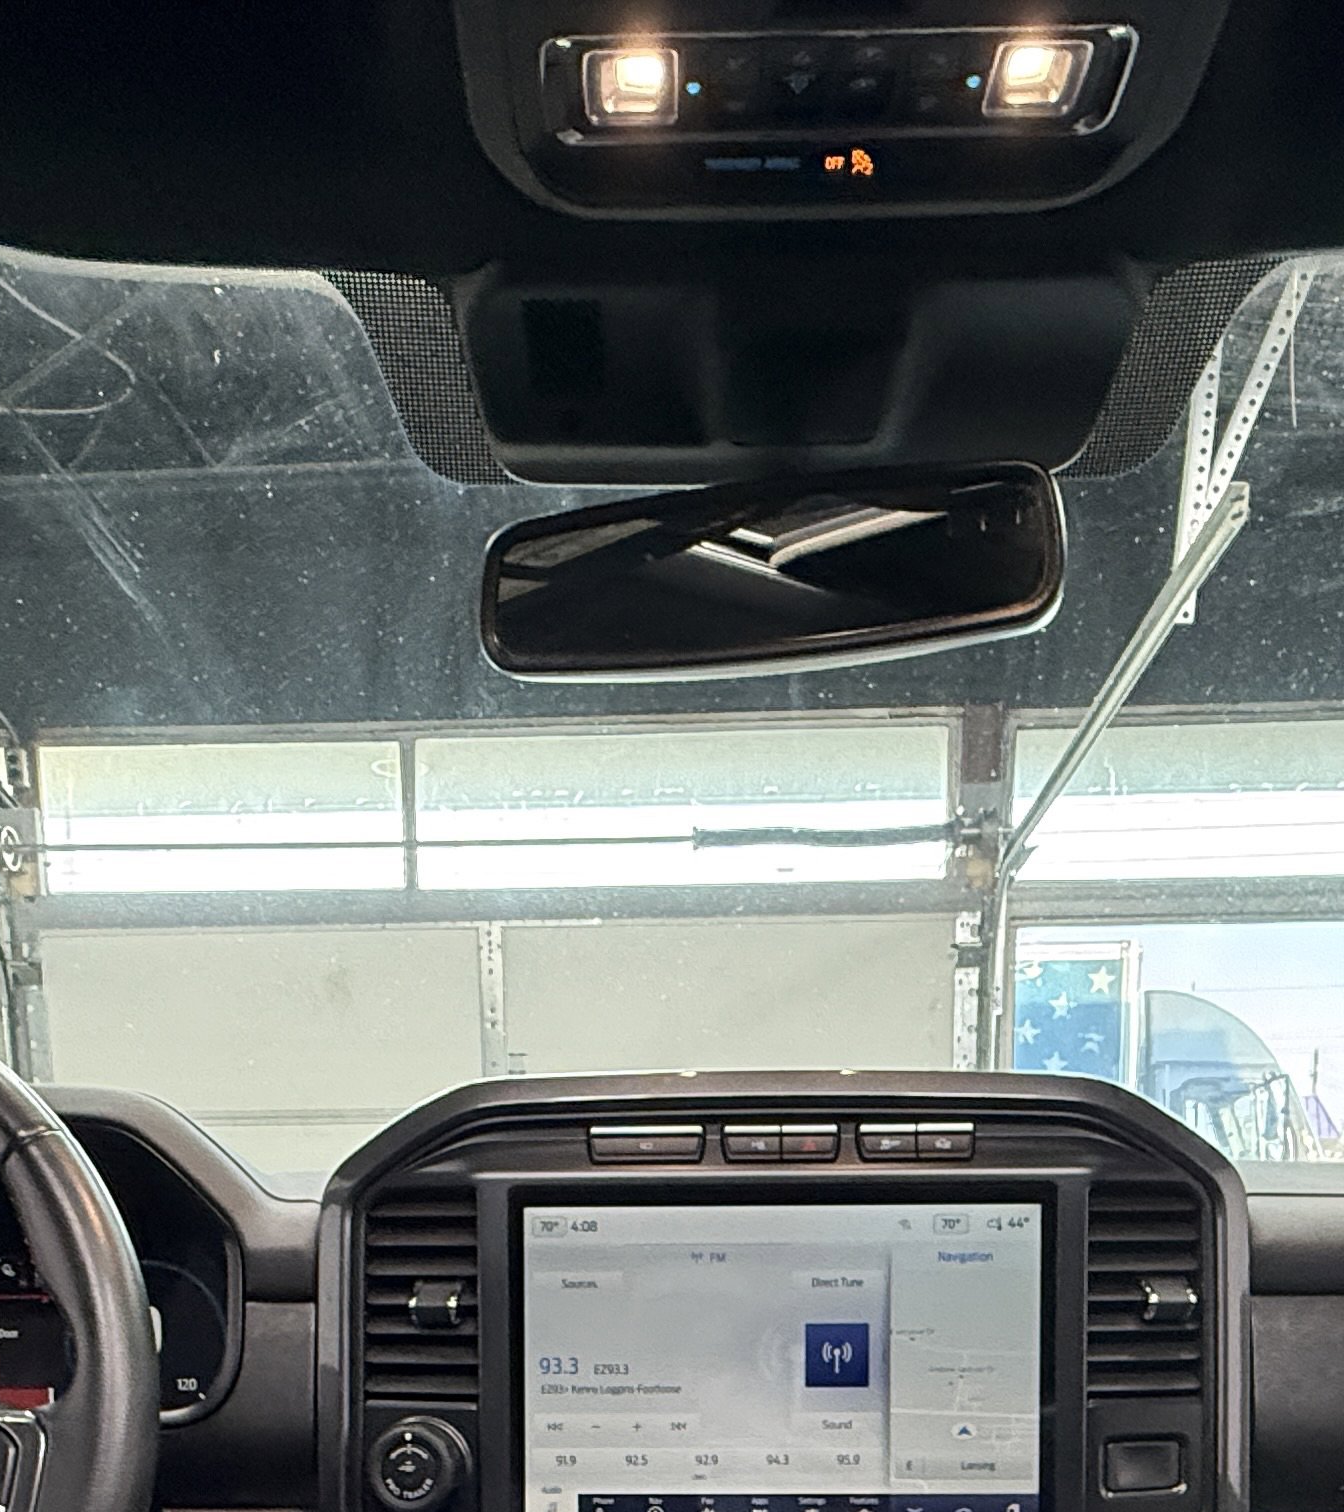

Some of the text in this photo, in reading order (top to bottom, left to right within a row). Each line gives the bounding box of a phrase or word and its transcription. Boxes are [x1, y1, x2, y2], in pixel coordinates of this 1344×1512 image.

[825, 156, 845, 170] OFF
[570, 1220, 598, 1232] 4:08
[937, 1251, 993, 1264] Navigation
[812, 1277, 864, 1288] Direct Tune
[539, 1357, 579, 1375] 93.3
[176, 1378, 198, 1391] 120
[822, 1420, 853, 1430] Sound
[625, 1455, 648, 1466] 92.5
[766, 1454, 790, 1465] 94.3
